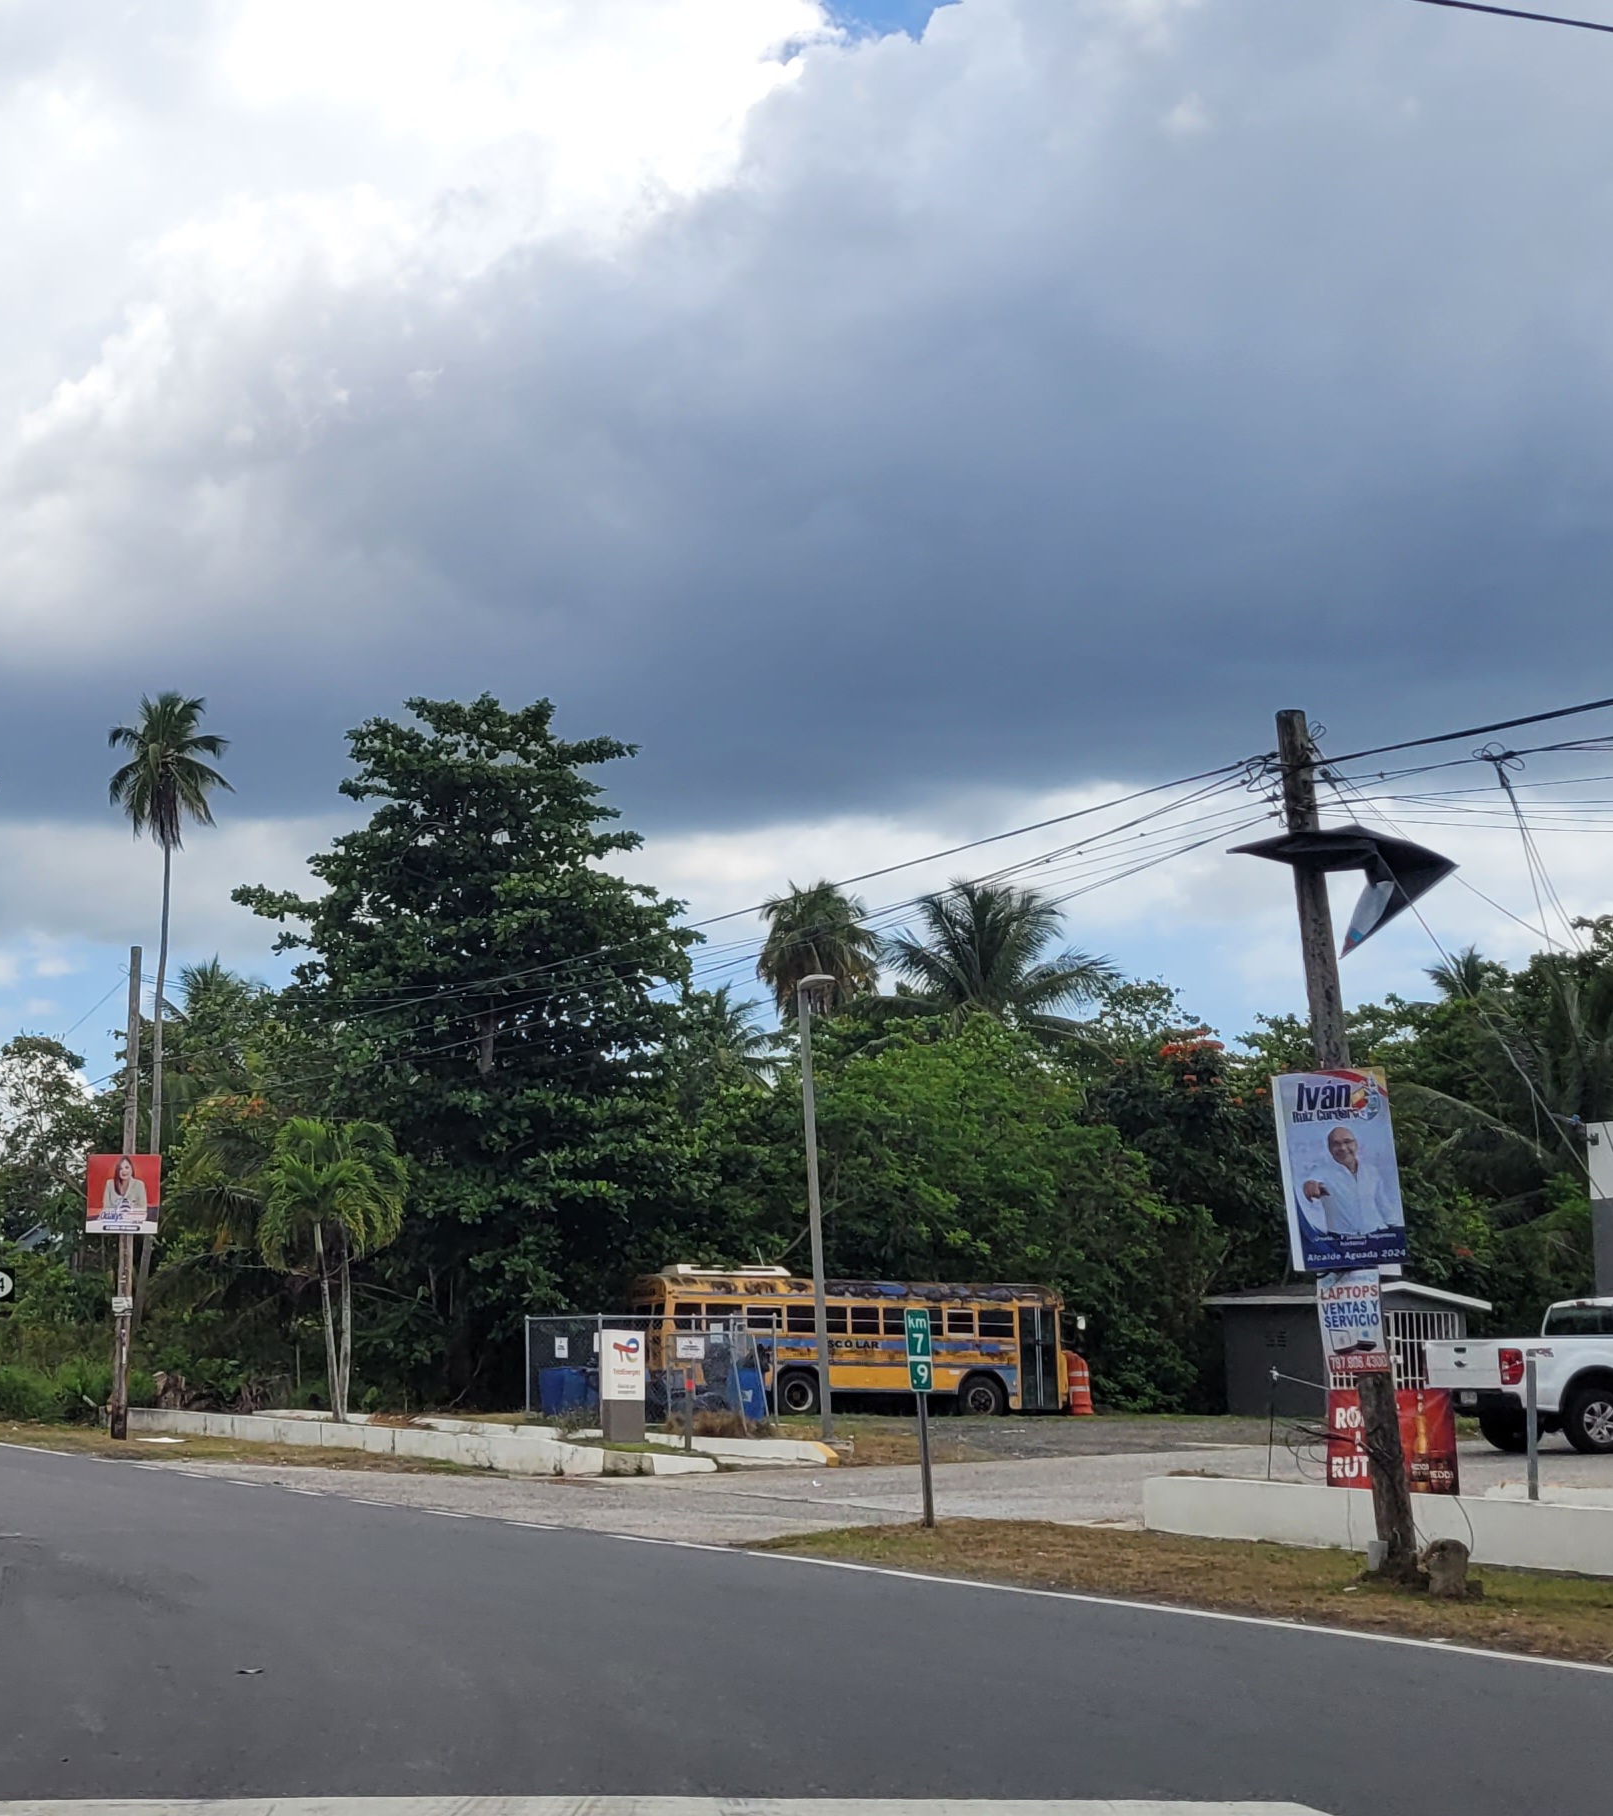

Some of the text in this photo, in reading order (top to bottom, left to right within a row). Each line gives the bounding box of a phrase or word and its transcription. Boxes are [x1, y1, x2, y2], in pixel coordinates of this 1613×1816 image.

[1297, 1080, 1351, 1112] Iván
[1292, 1111, 1314, 1123] Ruiz
[1307, 1248, 1406, 1262] Alcalde Aguada 2024
[1320, 1285, 1378, 1300] LAPTOPS
[1322, 1300, 1379, 1315] VENTAS Y
[907, 1314, 927, 1329] km
[1324, 1313, 1380, 1328] SERVICIO
[827, 1340, 880, 1350] SCOLAR
[912, 1333, 924, 1353] 7
[1335, 1405, 1365, 1429] RO
[1331, 1455, 1369, 1479] RUT
